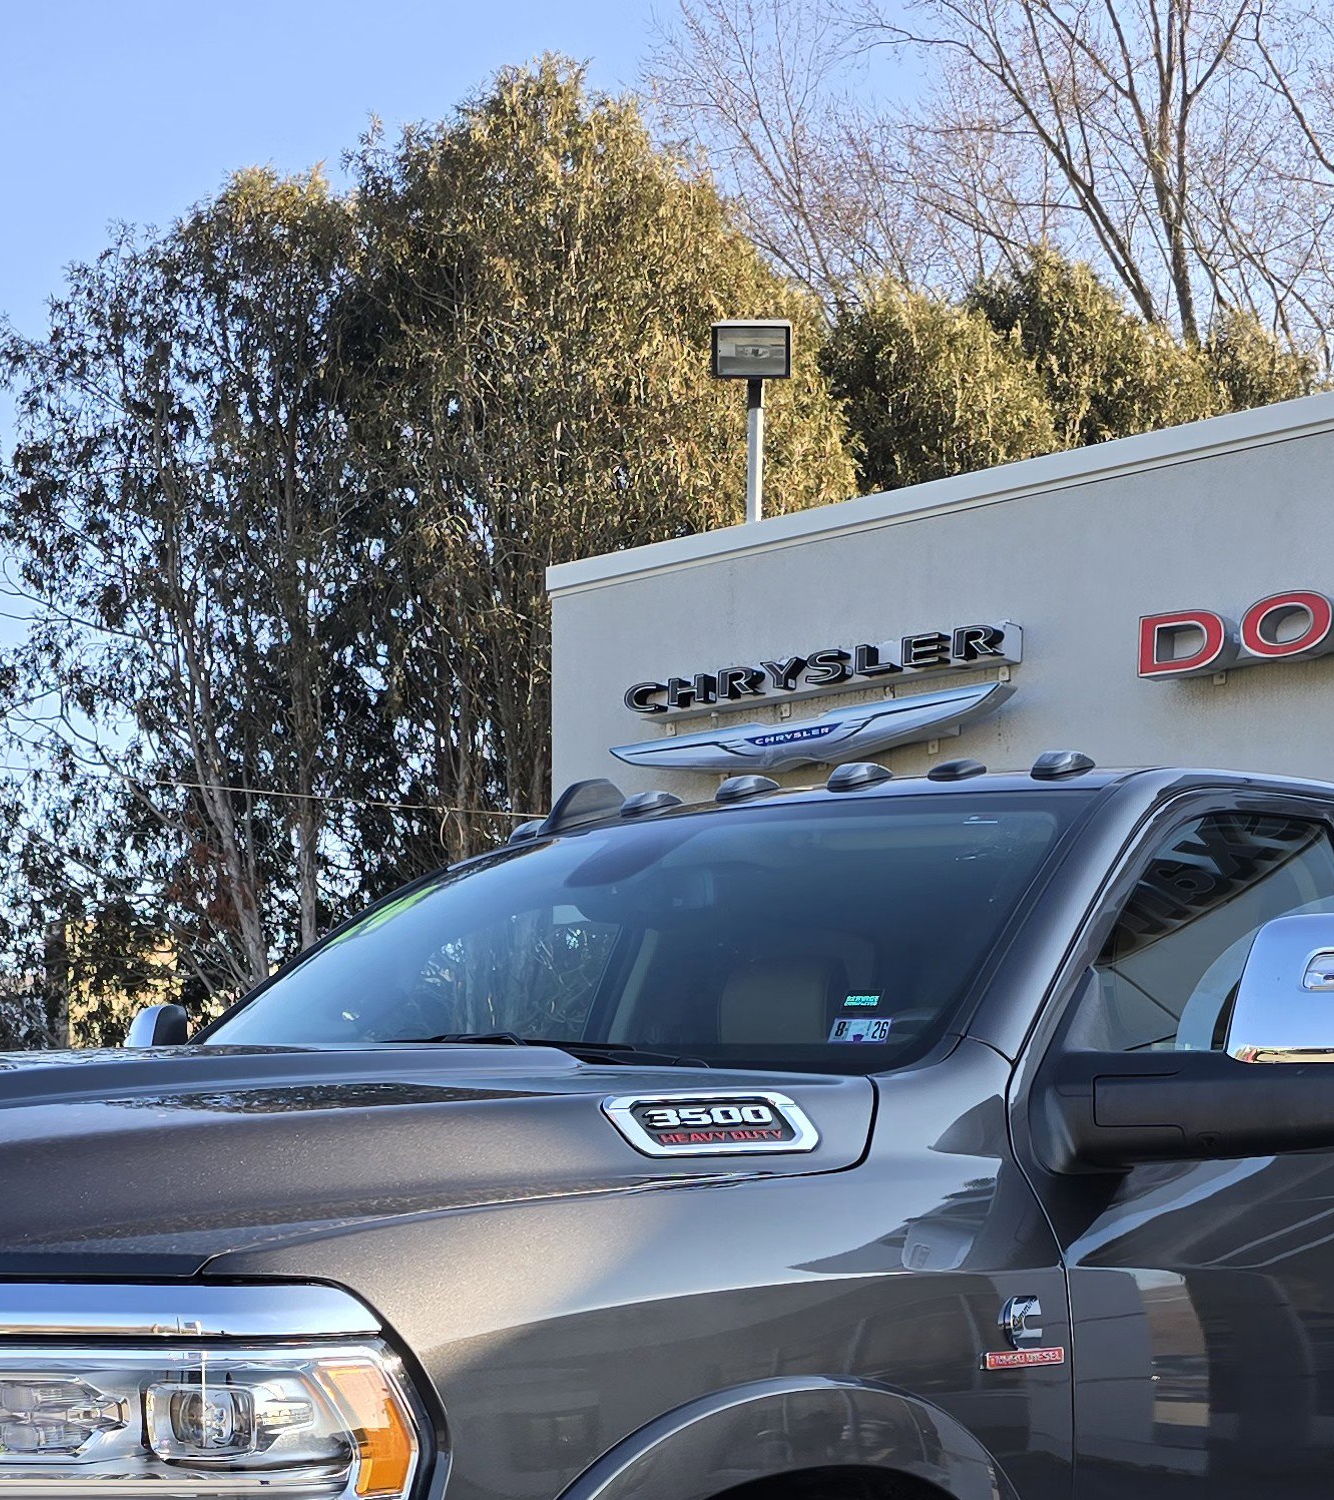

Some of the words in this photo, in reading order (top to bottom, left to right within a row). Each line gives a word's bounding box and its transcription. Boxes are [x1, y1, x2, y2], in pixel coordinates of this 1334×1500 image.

[624, 624, 1005, 714] CHRYSLER
[755, 727, 829, 745] CHRYSLER
[835, 1021, 847, 1037] 8
[871, 1021, 889, 1039] 26
[644, 1105, 773, 1127] 3500
[659, 1131, 726, 1144] HEAVY
[730, 1129, 782, 1141] DUTY
